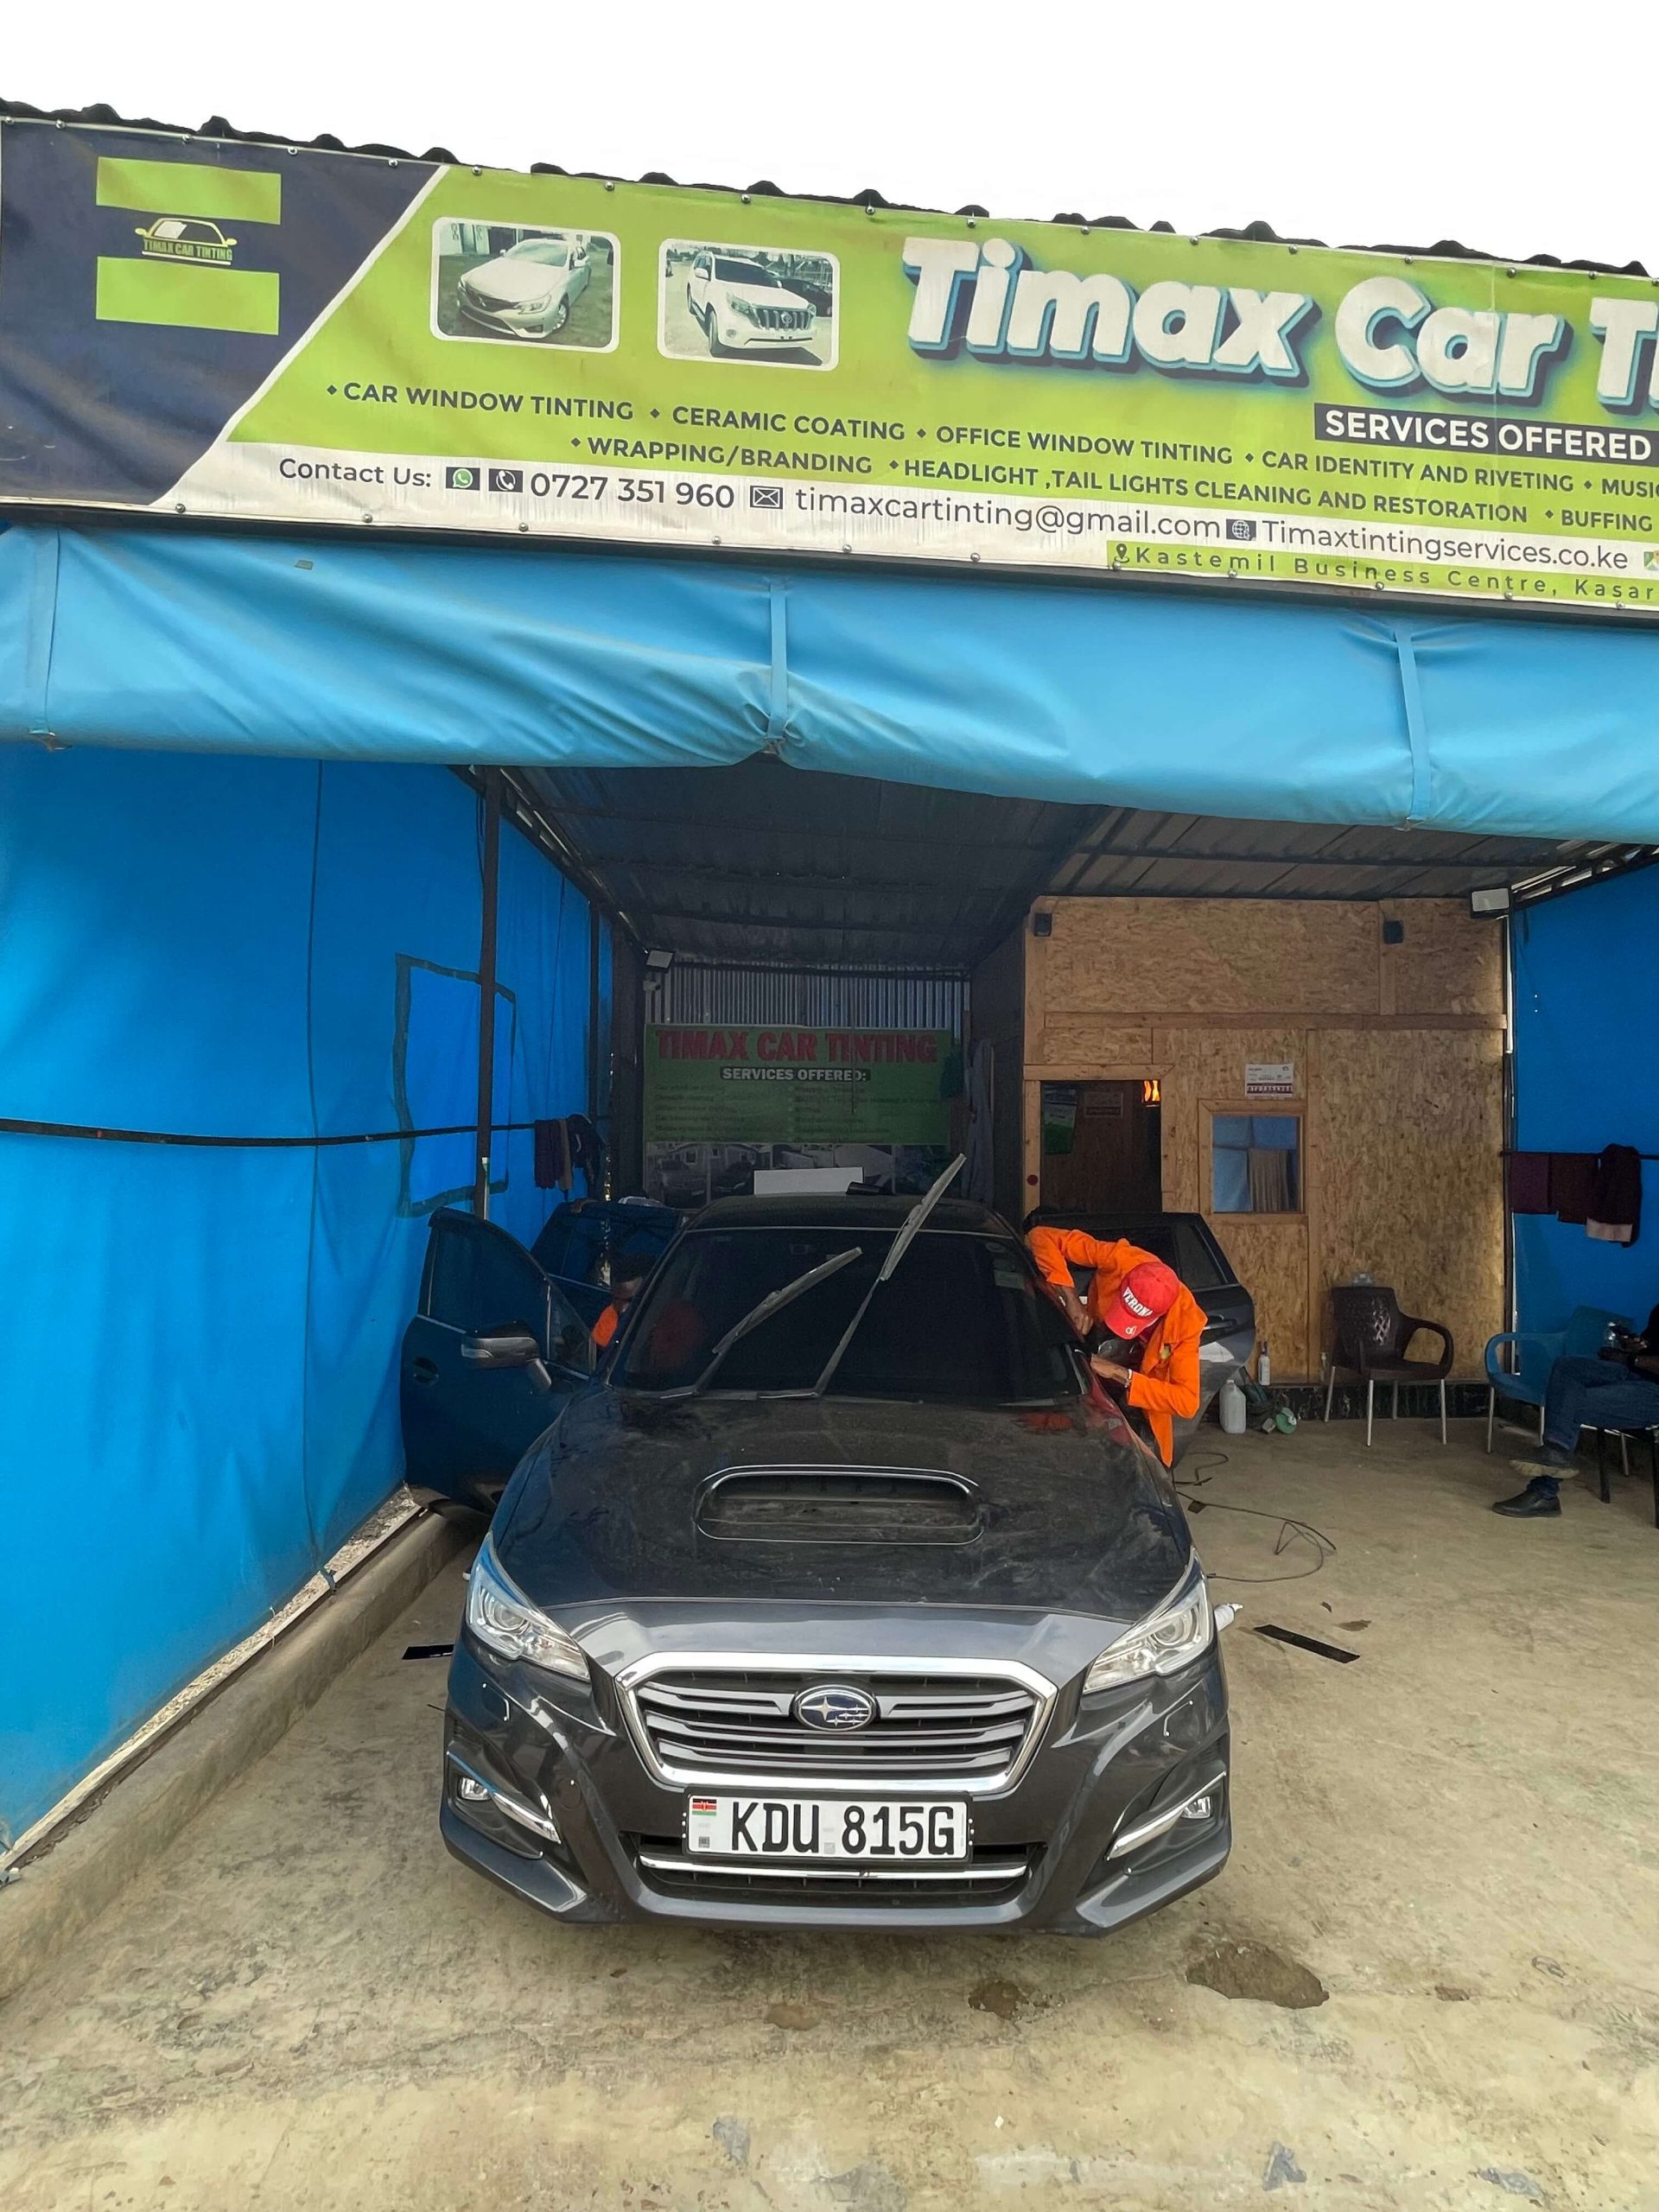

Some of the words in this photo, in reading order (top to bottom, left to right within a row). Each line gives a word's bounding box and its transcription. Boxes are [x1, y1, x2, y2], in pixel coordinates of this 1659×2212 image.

[175, 243, 194, 257] CAR
[903, 236, 1317, 378] Timax
[1335, 276, 1567, 399] Car
[1590, 296, 1659, 408] T
[344, 382, 398, 404] CAR
[406, 387, 524, 413] WINDOW
[531, 396, 633, 420] TINTING
[672, 406, 787, 431] CERAMIC
[794, 416, 906, 440] COATING
[937, 425, 1021, 448] OFFICE
[1027, 432, 1135, 456] WINDOW
[1141, 441, 1233, 465] TINTING
[1262, 450, 1308, 471] CAR
[1316, 454, 1414, 479] IDENTITY
[1420, 464, 1468, 485] AND
[1475, 469, 1574, 492] RIVETING
[1602, 479, 1659, 499] MUSI
[1325, 410, 1489, 448] SERVICES
[1498, 423, 1652, 461] OFFERED
[588, 437, 873, 474] WRAPPING/BRANDING
[905, 459, 1039, 486] HEADLIGHT
[1109, 474, 1188, 496] LIGHTS
[1195, 481, 1312, 505] CLEANING
[1318, 491, 1367, 511] AND
[1374, 495, 1528, 523] RESTORATION
[1561, 509, 1653, 532] BUFFING
[279, 458, 384, 484] Contact
[394, 467, 432, 487] Us:
[531, 473, 609, 500] 0727
[618, 478, 665, 503] 351
[676, 481, 735, 508] 960
[795, 486, 1220, 537] timaxcartinting@gmail.com
[1262, 519, 1628, 570] Timaxtintingservices.co.ke
[1135, 546, 1274, 571] Kastemil
[1294, 558, 1430, 583] Business
[1447, 570, 1557, 595] Centre,
[1575, 579, 1654, 600] Kasar
[656, 1029, 750, 1060] TIMAX
[757, 1032, 817, 1062] CAR
[825, 1032, 938, 1063] TINTING
[722, 1066, 794, 1081] SERVICES
[732, 1802, 820, 1853] KDU
[842, 1805, 955, 1855] 815G
